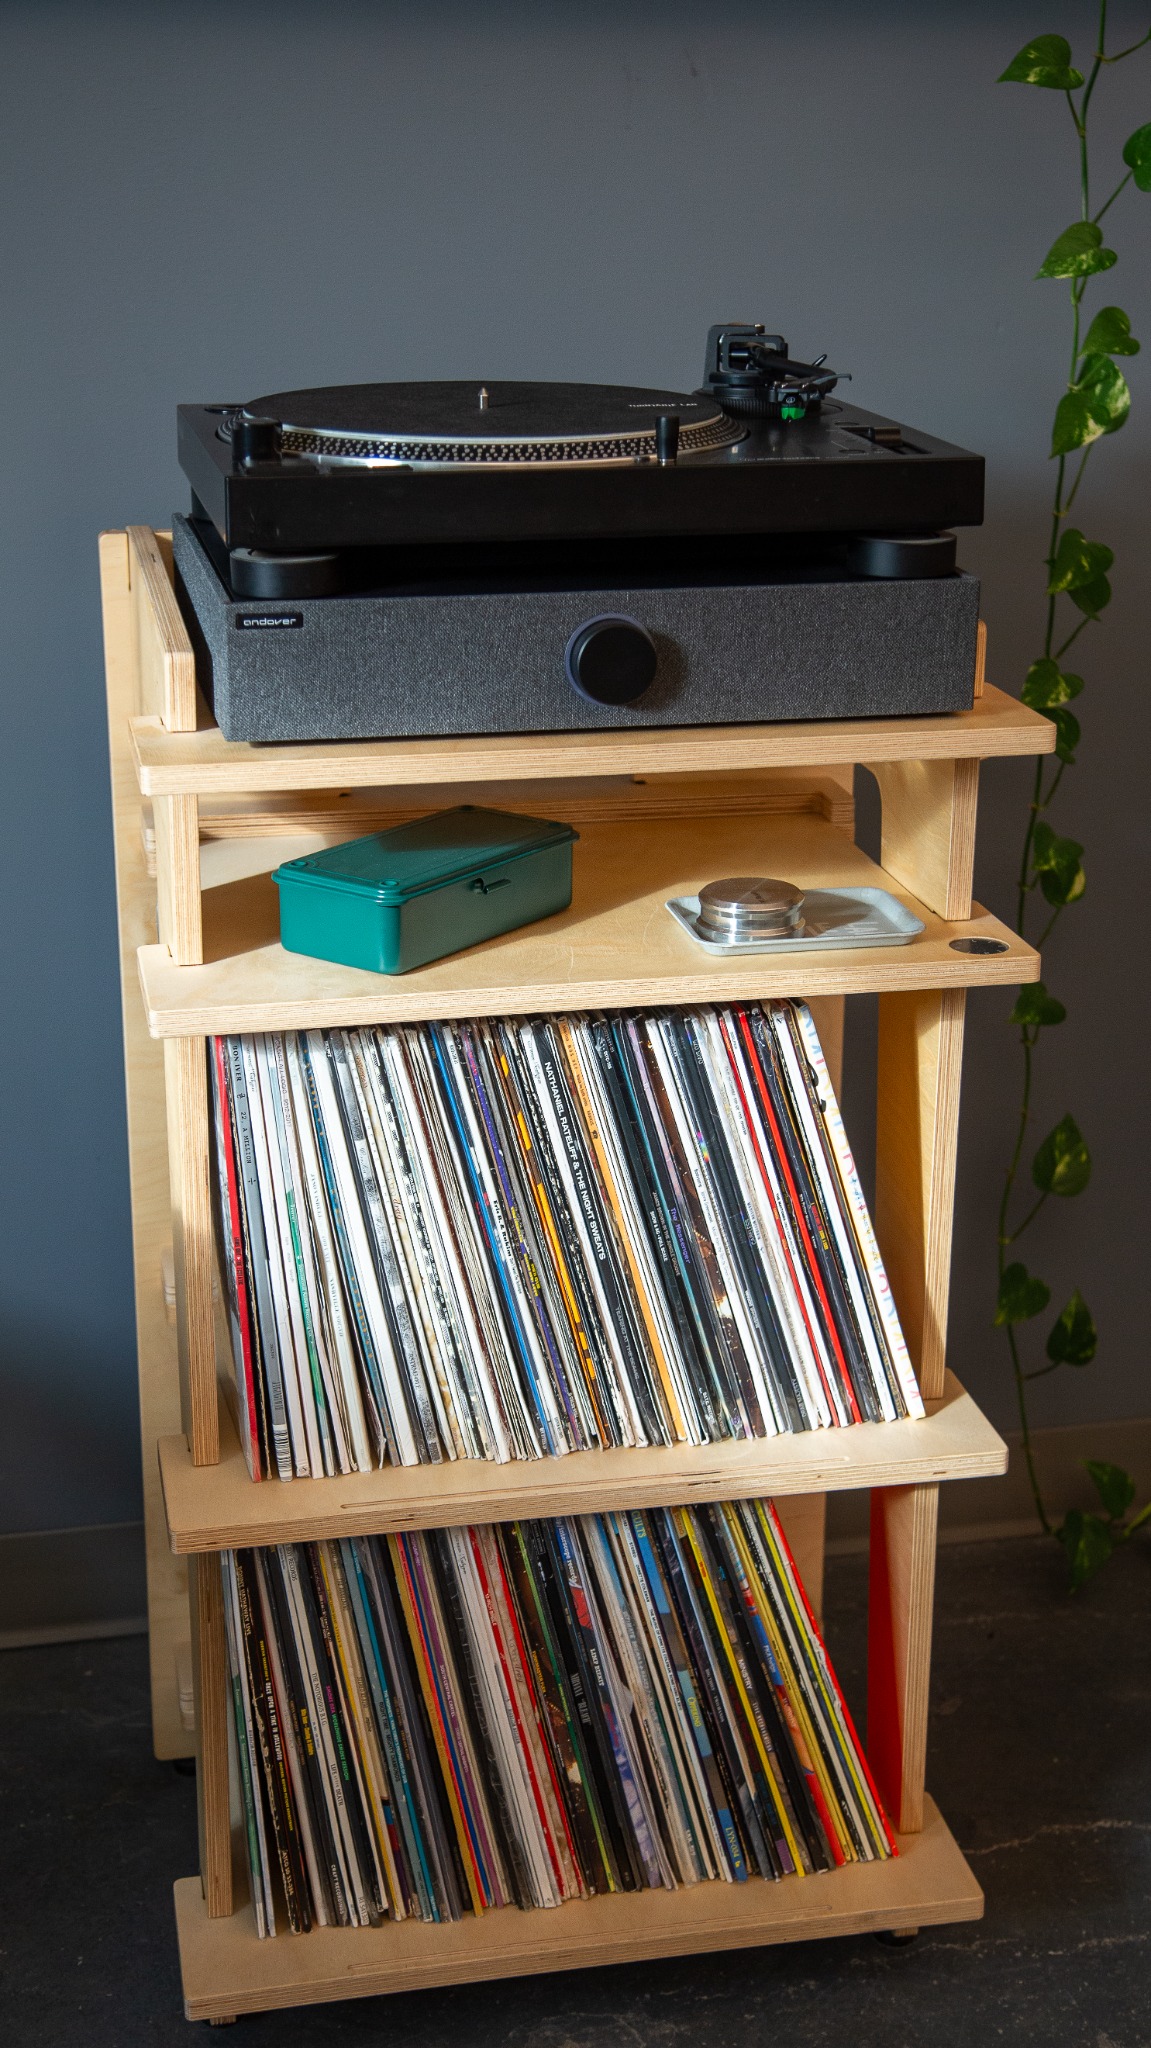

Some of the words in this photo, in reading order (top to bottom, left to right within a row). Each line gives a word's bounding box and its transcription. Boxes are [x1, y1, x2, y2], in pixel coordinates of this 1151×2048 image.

[243, 617, 296, 627] andover
[545, 1061, 563, 1116] NATHANIEL
[561, 1116, 576, 1161] RATELIFF
[572, 1161, 580, 1169] &
[575, 1170, 585, 1189] THE
[582, 1190, 593, 1220] NIGHT
[502, 1231, 511, 1256] Rakim
[590, 1220, 604, 1260] SWEATS
[670, 1207, 678, 1220] The
[676, 1224, 689, 1264] Messenger
[615, 1307, 625, 1334] TEARING
[622, 1334, 628, 1342] AT
[632, 1510, 645, 1538] CULTS
[288, 1558, 296, 1581] RECORDS
[566, 1559, 577, 1583] records
[635, 1564, 643, 1582] ORNETTE
[641, 1583, 650, 1602] COLEMAN
[240, 1588, 248, 1621] HATHAWAY
[657, 1635, 665, 1653] ORNETTE
[590, 1648, 598, 1665] LIMP
[594, 1665, 604, 1686] BIZKIT
[737, 1658, 752, 1690] MINISTRY
[315, 1683, 323, 1712] NOTORIOUS
[267, 1695, 275, 1708] UPON
[273, 1733, 282, 1760] HOLLYWOOD
[332, 1713, 340, 1742] WORLDWIDE
[341, 1760, 349, 1780] SESSION
[391, 1754, 399, 1781] DIAMONDS
[335, 1788, 343, 1805] DEATH
[726, 1826, 738, 1857] LYN-034
[330, 1864, 338, 1881] CRAFT
[333, 1881, 344, 1914] RECORDINGS
